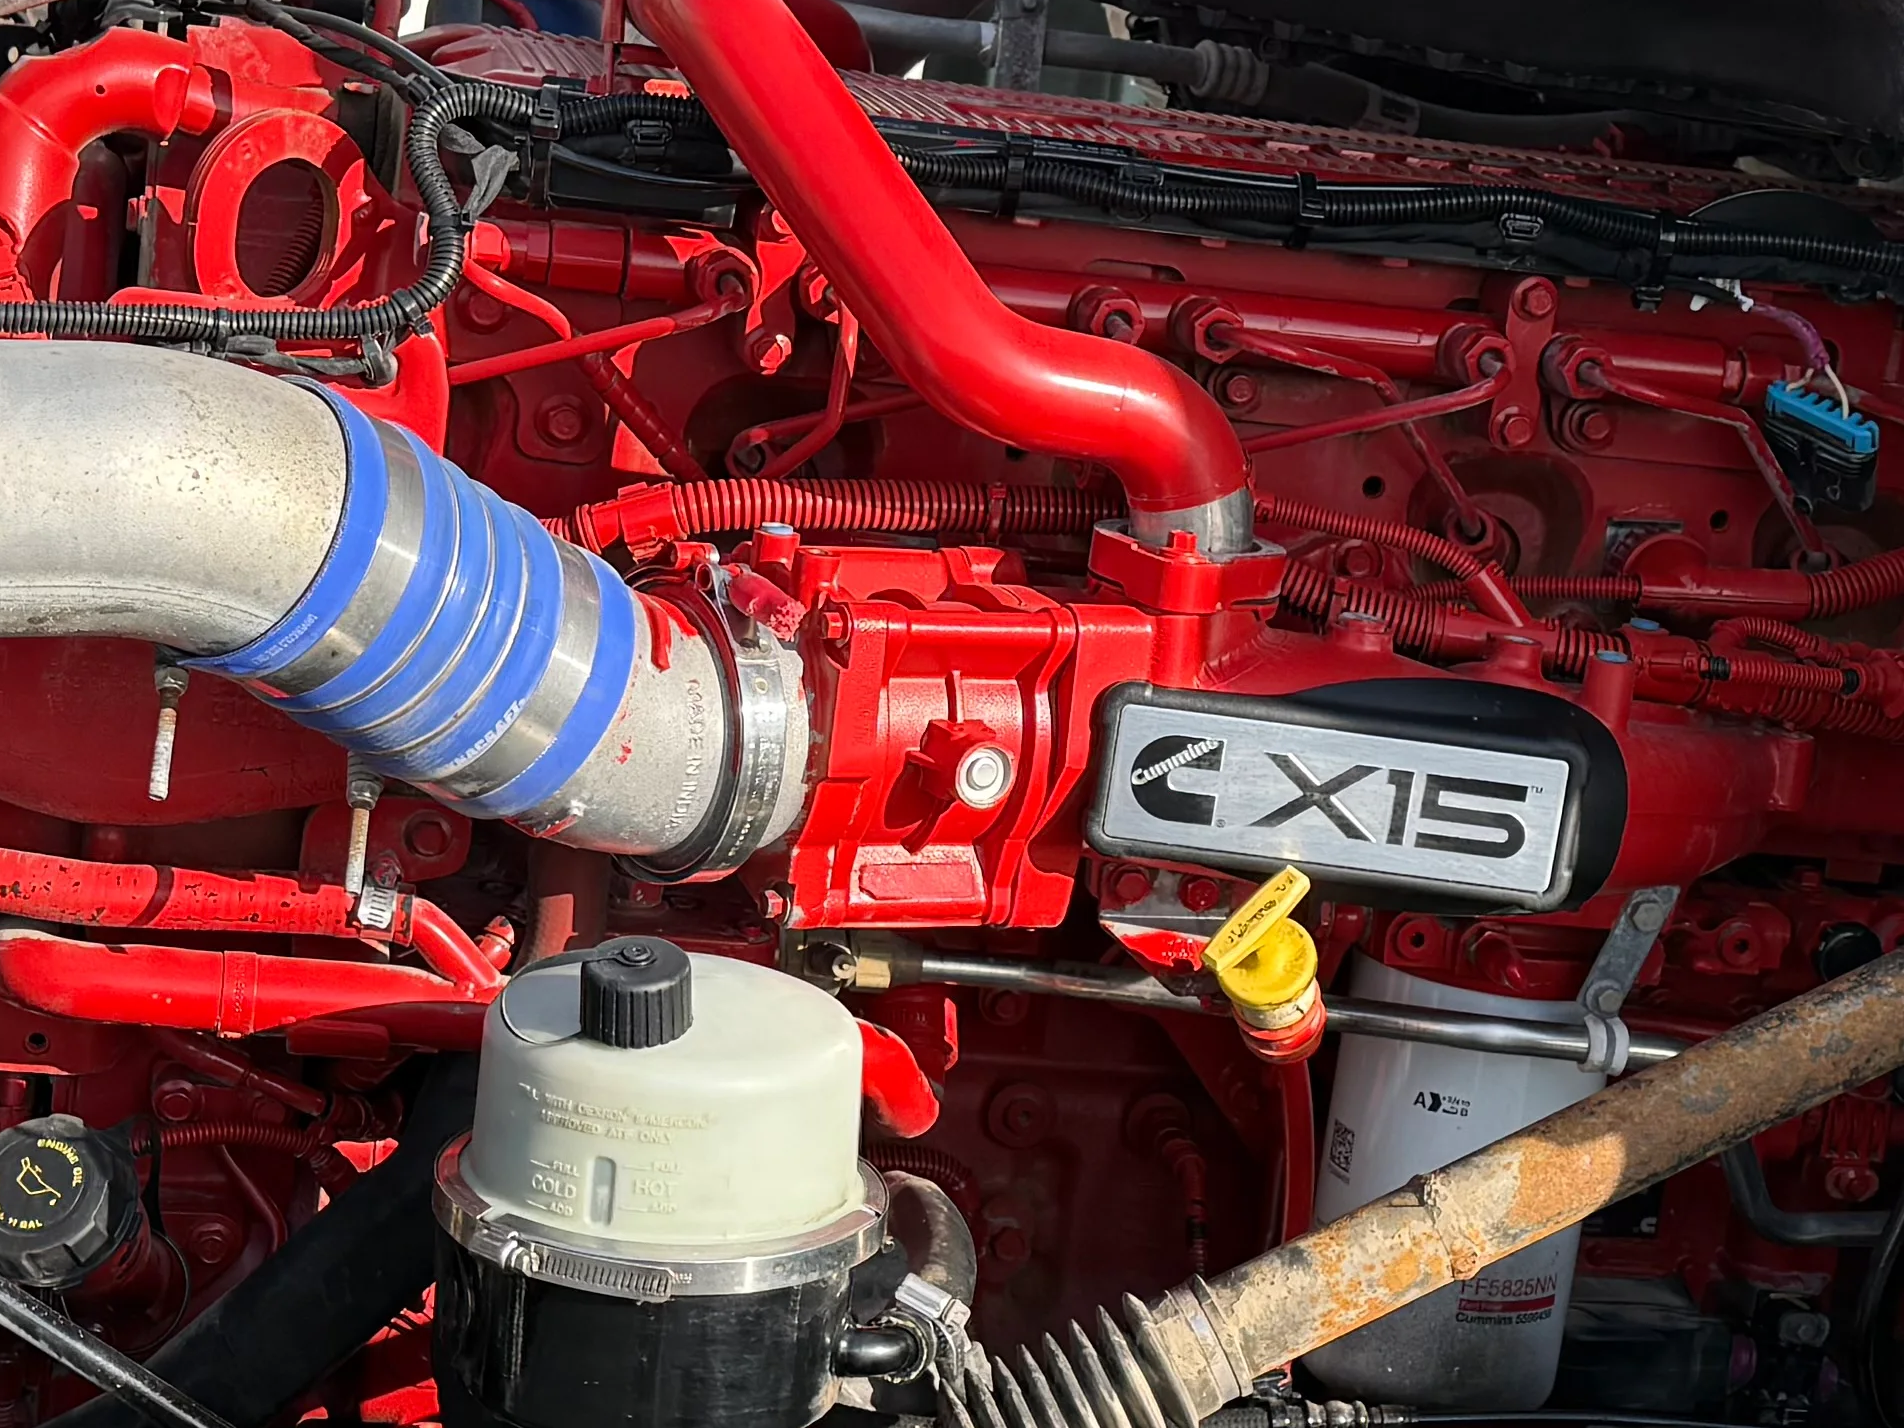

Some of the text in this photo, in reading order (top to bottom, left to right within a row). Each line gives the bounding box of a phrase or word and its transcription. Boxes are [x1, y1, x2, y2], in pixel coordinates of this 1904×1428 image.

[1130, 736, 1221, 786] Cummins
[1248, 750, 1529, 860] X15
[531, 1174, 680, 1199] COLD HOT
[549, 1201, 575, 1217] ADD
[1455, 1310, 1513, 1327] Cummins
